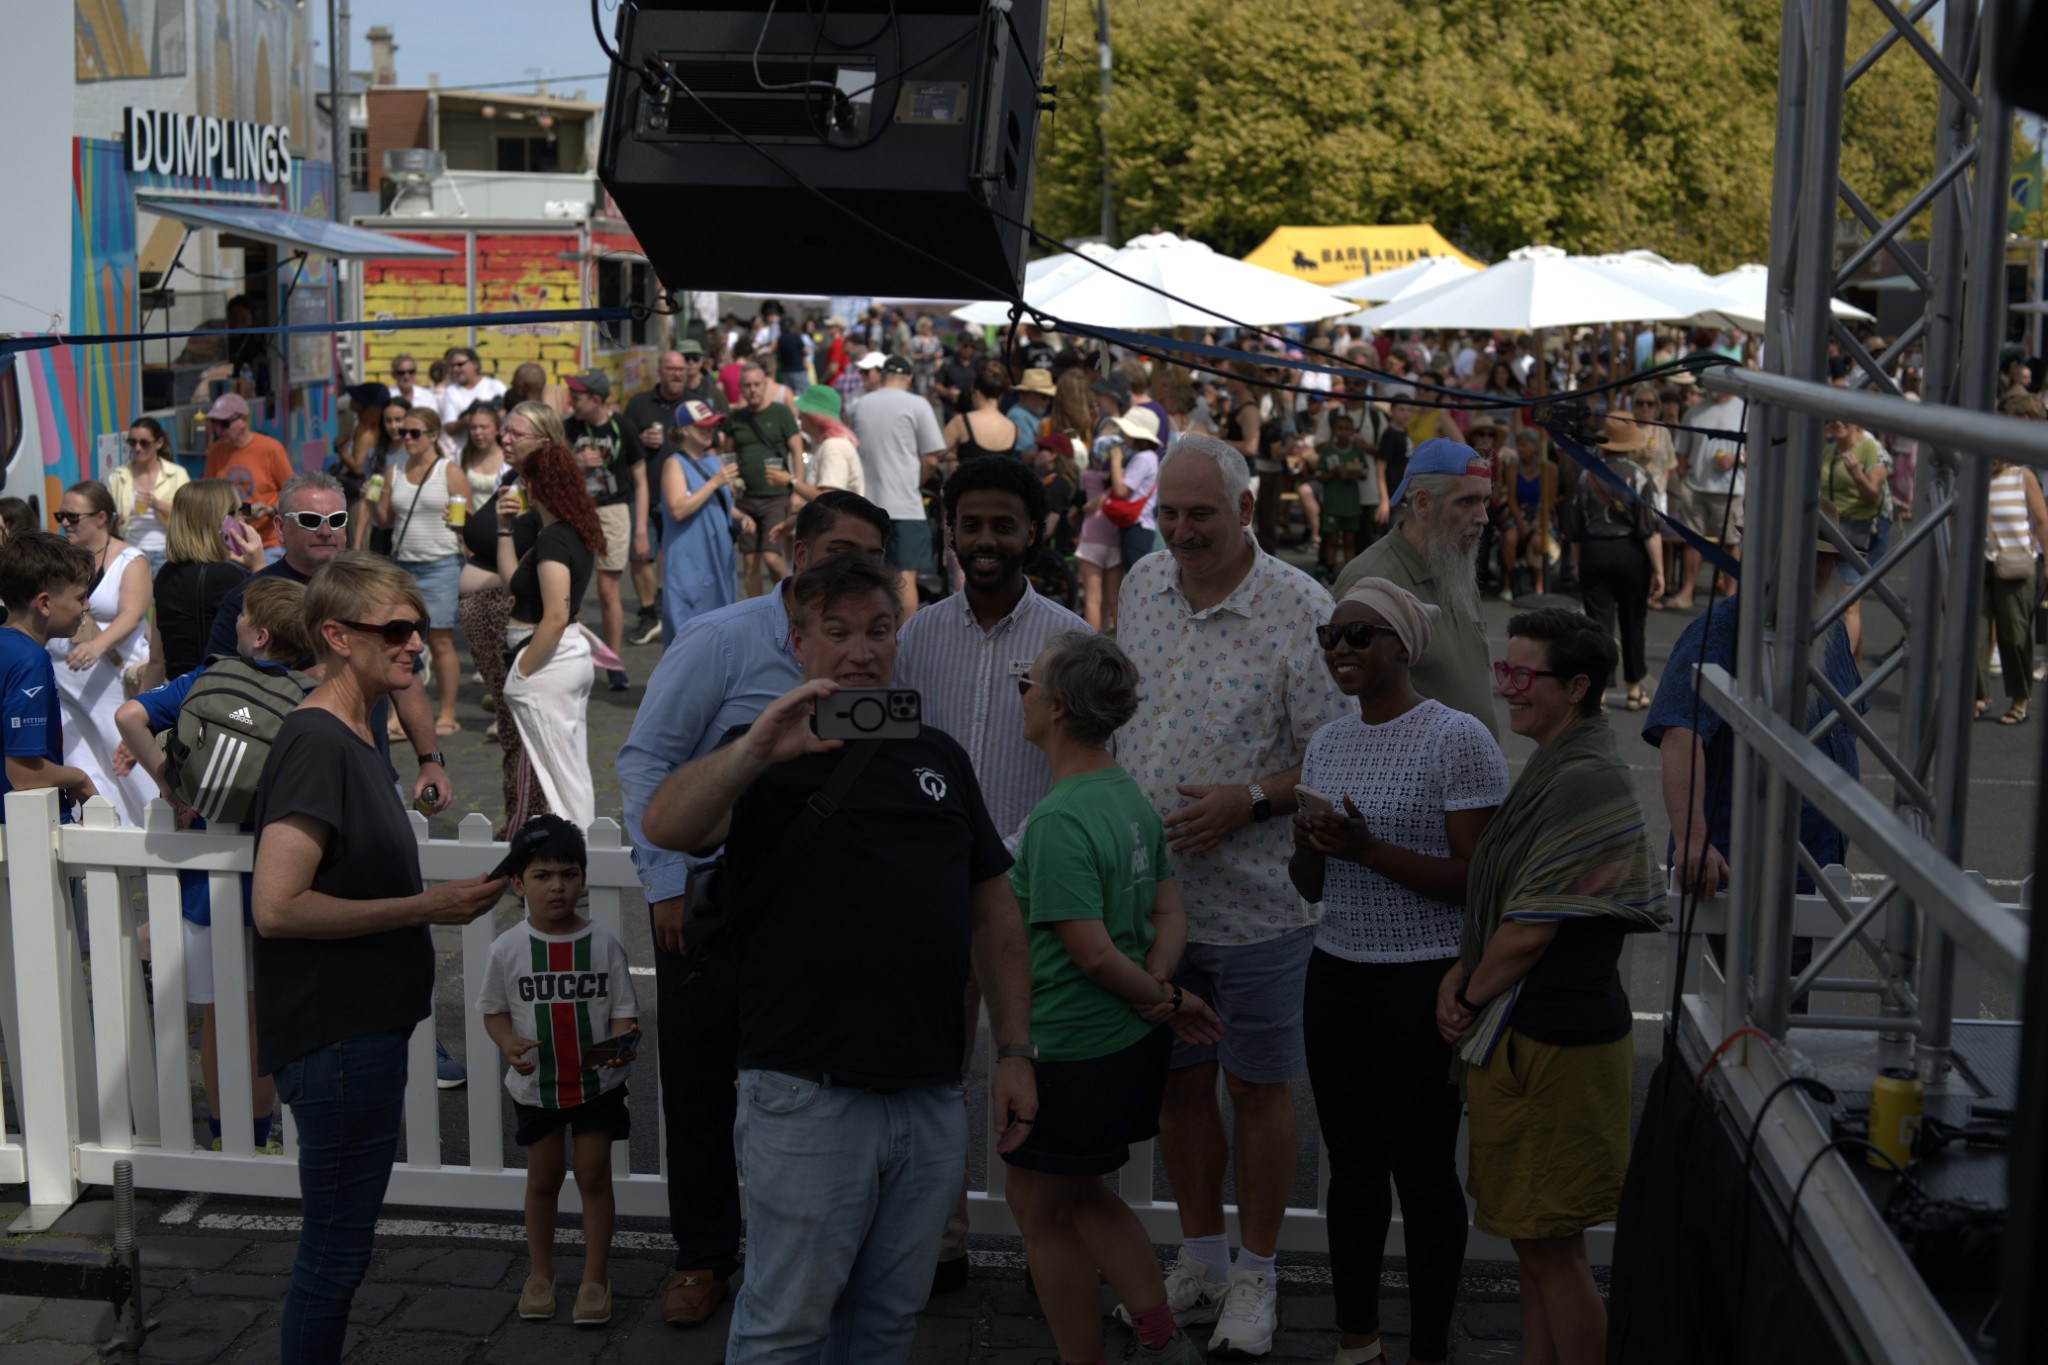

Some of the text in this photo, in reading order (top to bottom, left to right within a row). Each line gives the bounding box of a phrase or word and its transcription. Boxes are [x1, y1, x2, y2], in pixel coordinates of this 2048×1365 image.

[131, 107, 292, 184] DUMPLINGS
[229, 713, 254, 726] adidas
[518, 973, 609, 1002] GUCCI
